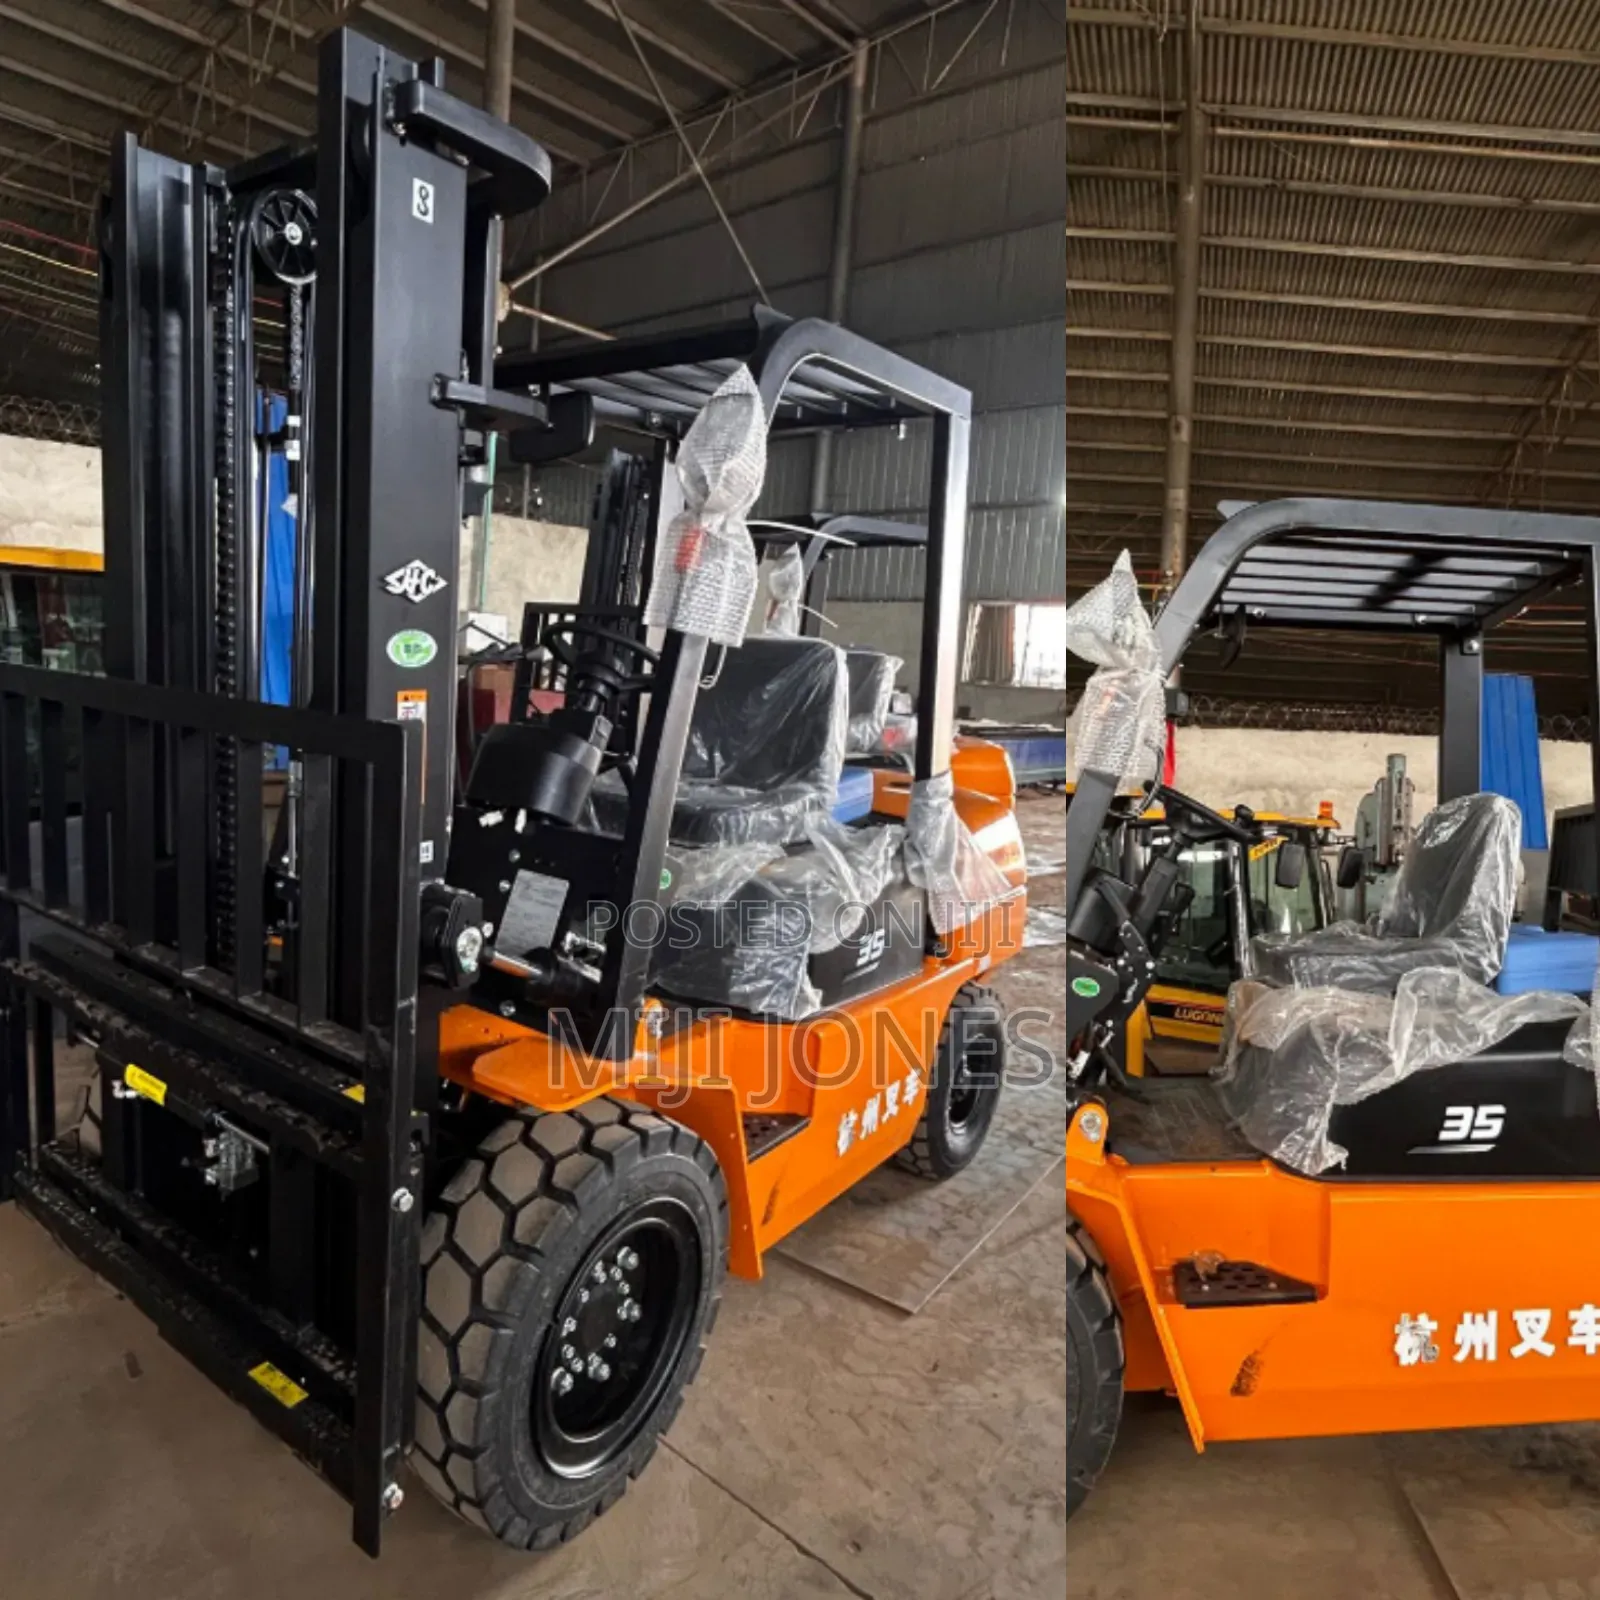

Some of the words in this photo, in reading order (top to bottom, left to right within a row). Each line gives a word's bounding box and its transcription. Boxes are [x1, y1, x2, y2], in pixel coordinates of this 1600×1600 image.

[856, 928, 887, 967] 35
[1174, 1006, 1223, 1024] LUGON
[1438, 1104, 1506, 1141] 35
[1394, 1303, 1600, 1367] 杭州叉车
